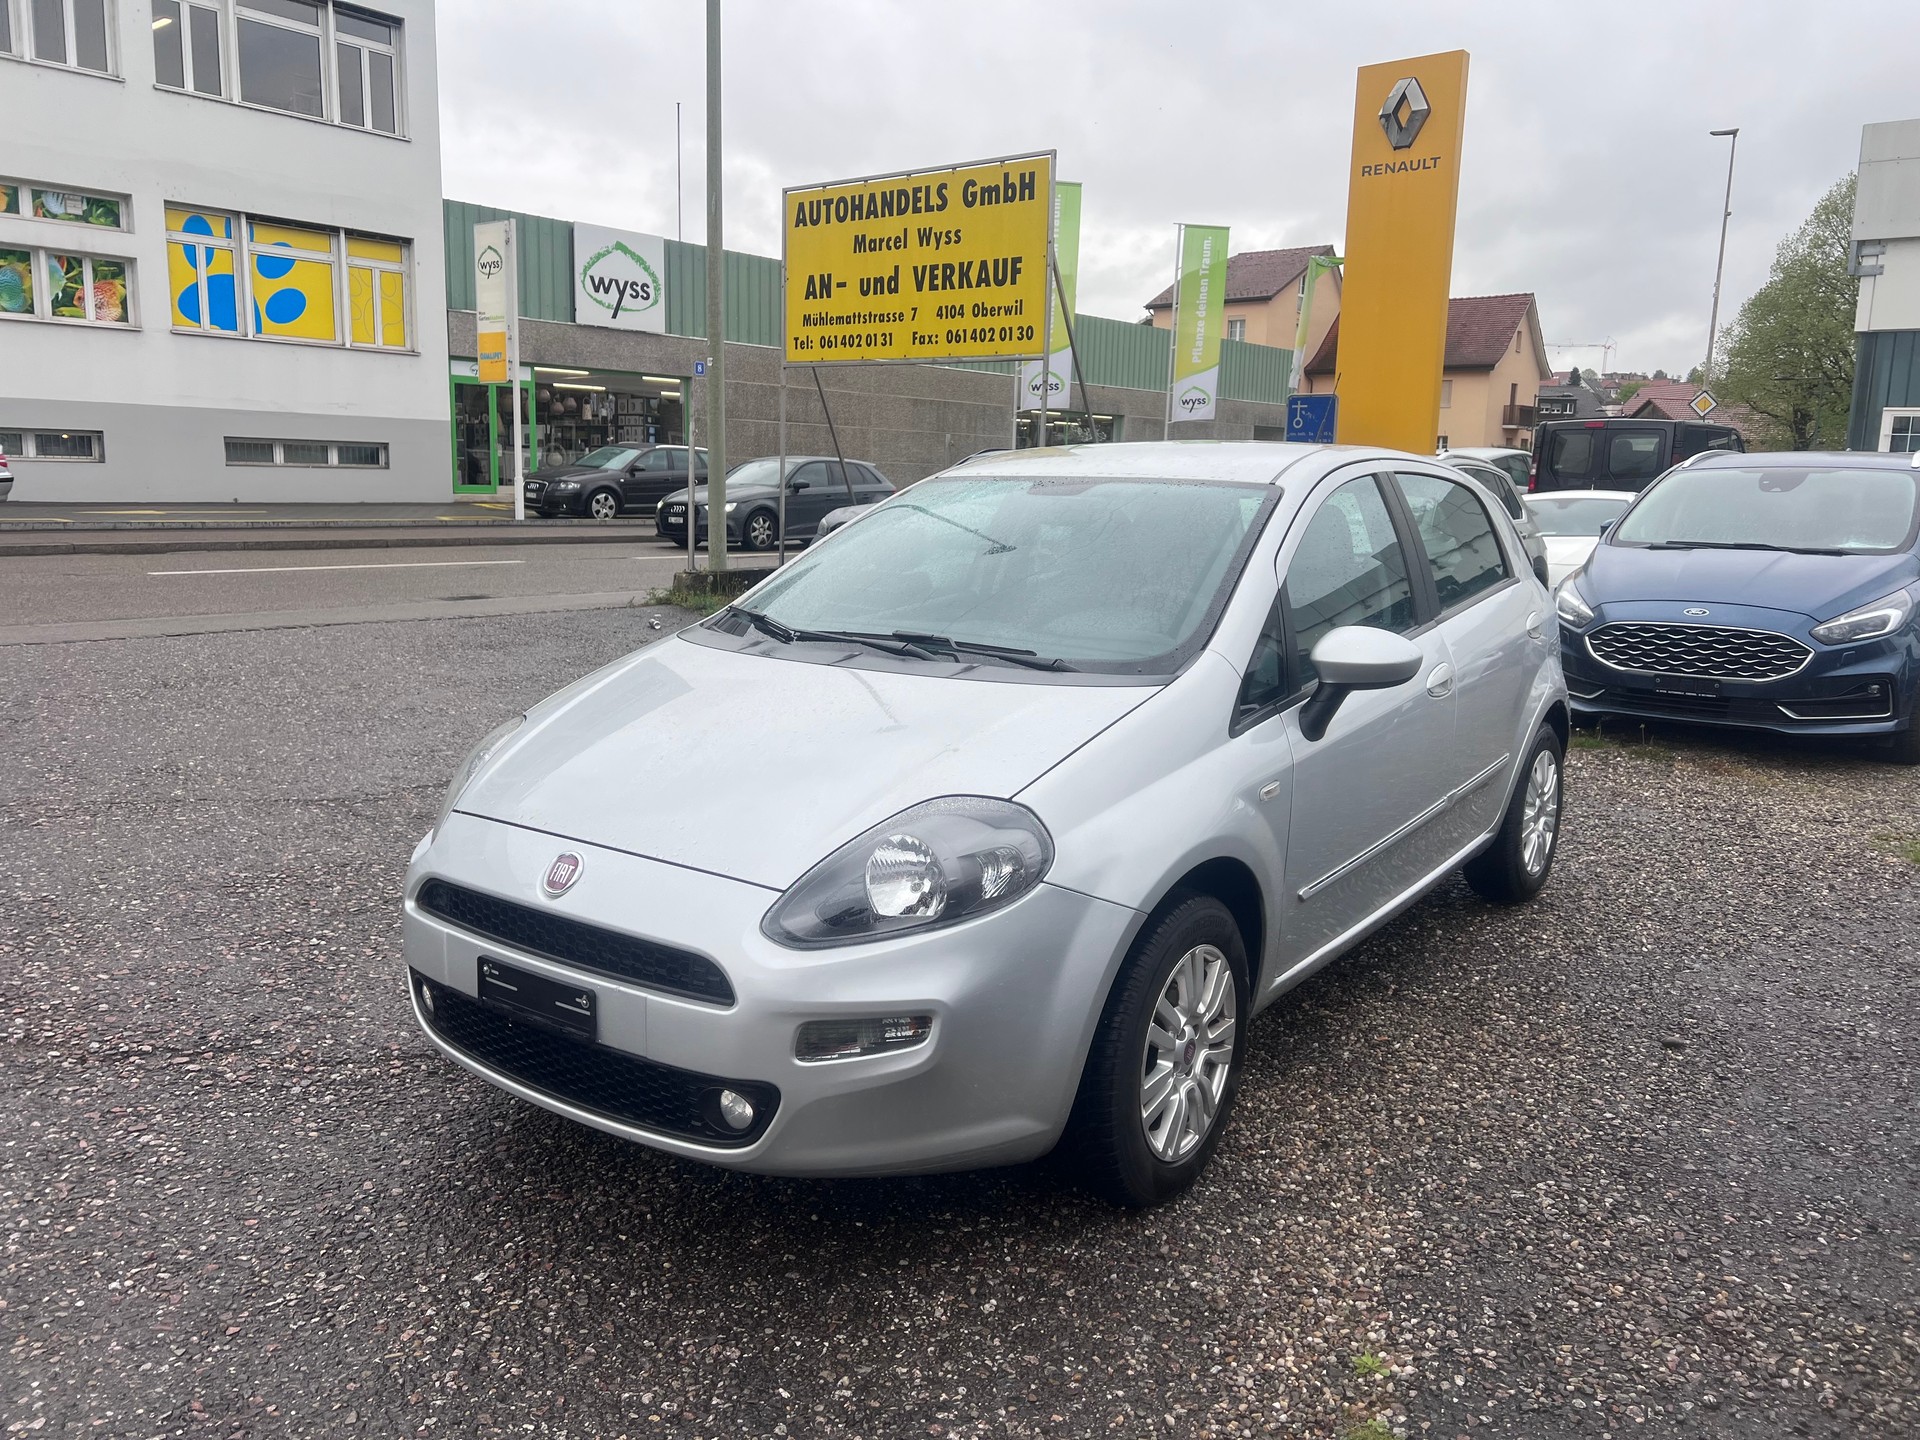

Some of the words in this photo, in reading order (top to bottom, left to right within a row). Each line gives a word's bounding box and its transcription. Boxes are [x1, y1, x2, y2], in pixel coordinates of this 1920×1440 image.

[1361, 156, 1441, 177] RENAULT
[794, 182, 948, 228] AUTOHANDELS
[962, 170, 1036, 209] GmbH
[853, 227, 908, 254] Marcel
[917, 226, 962, 251] Wyss
[1199, 236, 1213, 276] Traum.
[480, 260, 500, 279] wyss
[859, 265, 900, 297] und
[913, 256, 1023, 293] VERKAUF
[589, 275, 651, 319] wyss
[1196, 278, 1209, 318] deinen
[802, 310, 905, 327] Mühlemattstrasse
[911, 307, 918, 321] 7
[936, 304, 965, 320] 4104
[972, 299, 1024, 318] Oberwil
[793, 335, 814, 350] Tel:
[912, 331, 939, 346] Fax:
[1192, 319, 1206, 363] Pflanze
[697, 364, 703, 373] 8
[1031, 382, 1060, 401] wss
[1181, 397, 1207, 413] wyss
[550, 862, 576, 884] FIAT
